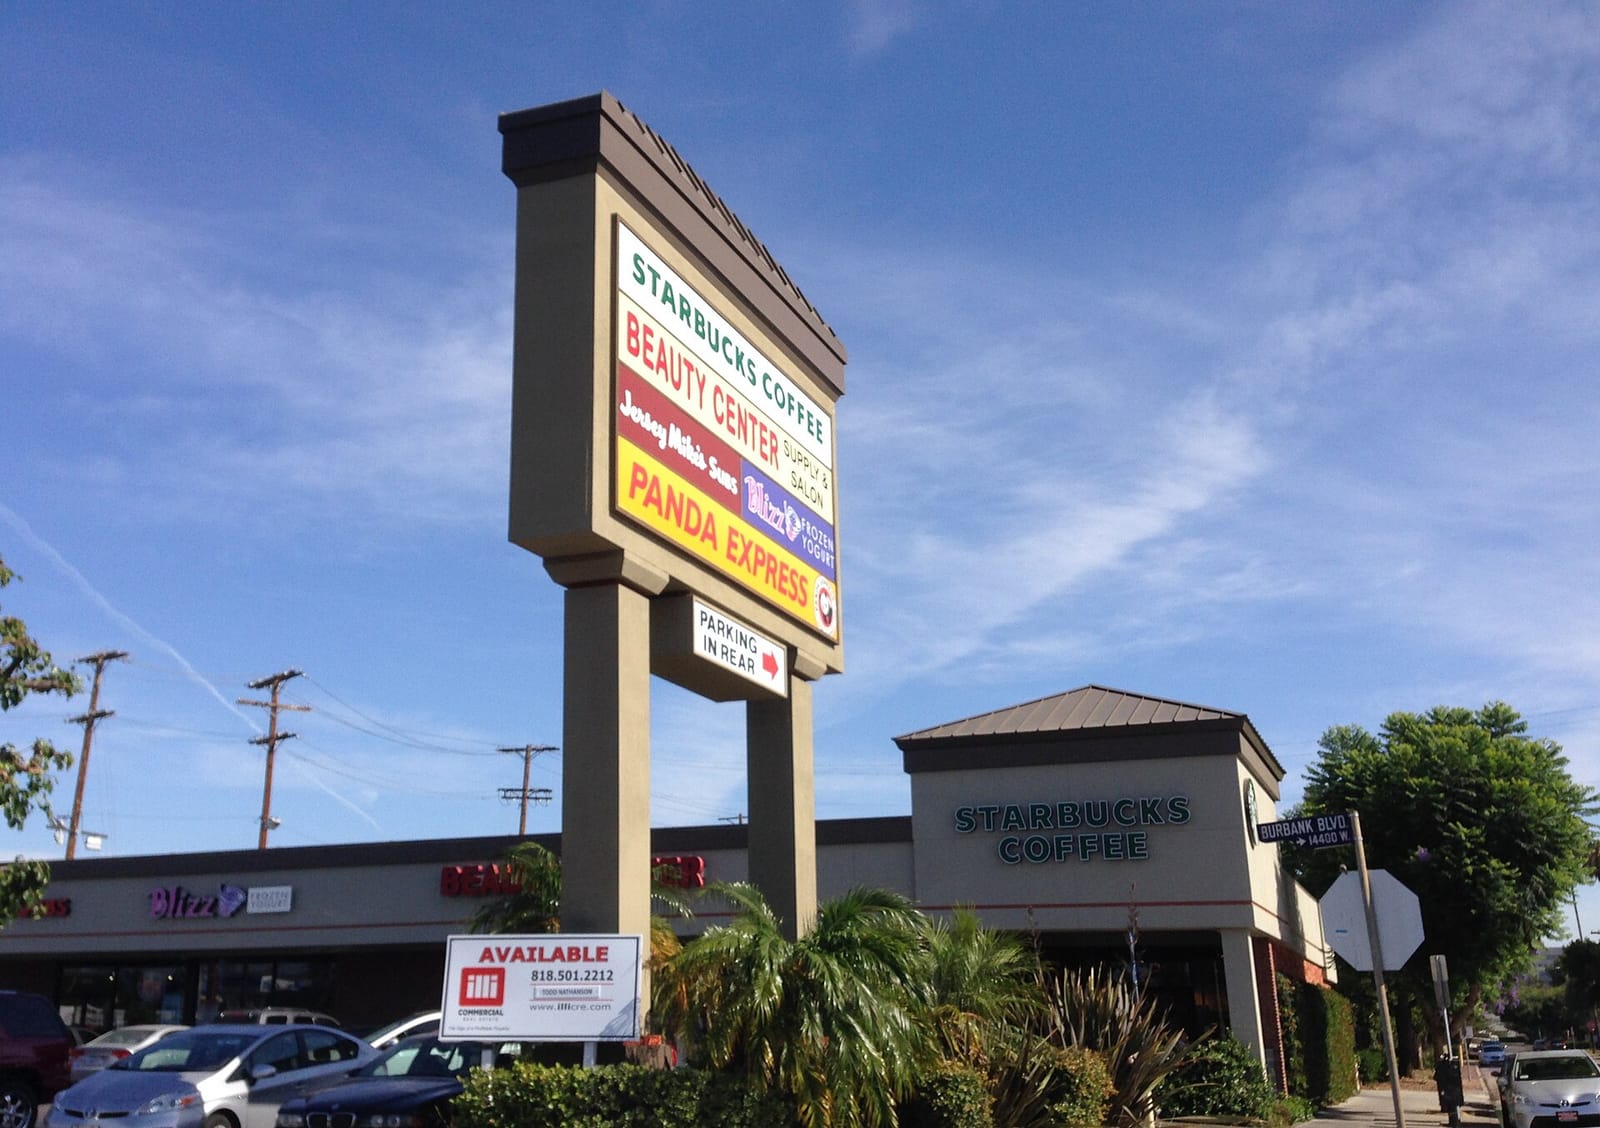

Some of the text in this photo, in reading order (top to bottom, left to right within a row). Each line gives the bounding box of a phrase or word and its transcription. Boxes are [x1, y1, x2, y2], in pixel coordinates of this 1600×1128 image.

[632, 252, 824, 445] STARBUCKS COFFEE
[626, 310, 779, 471] BEAUTY CENTER
[619, 389, 667, 450] Jersey
[668, 422, 707, 470] Mike's
[783, 439, 819, 481] SUPPLY
[743, 475, 785, 535] Blizz
[790, 470, 823, 509] SALON
[628, 462, 809, 608] PANDA EXPRESS
[801, 517, 834, 553] FROZEN
[801, 534, 834, 569] YOGURT
[700, 610, 757, 654] PARKING
[703, 634, 755, 675] IN REAR
[955, 796, 1191, 833] STARBUCKS
[1260, 819, 1313, 839] BURBANK
[998, 831, 1149, 864] COFFEE
[1308, 832, 1337, 846] 14400
[148, 885, 217, 919] Blizz
[478, 946, 609, 963] AVAILABLE
[531, 970, 614, 981] 818.501.2212
[529, 1003, 612, 1011] www.illicre.com
